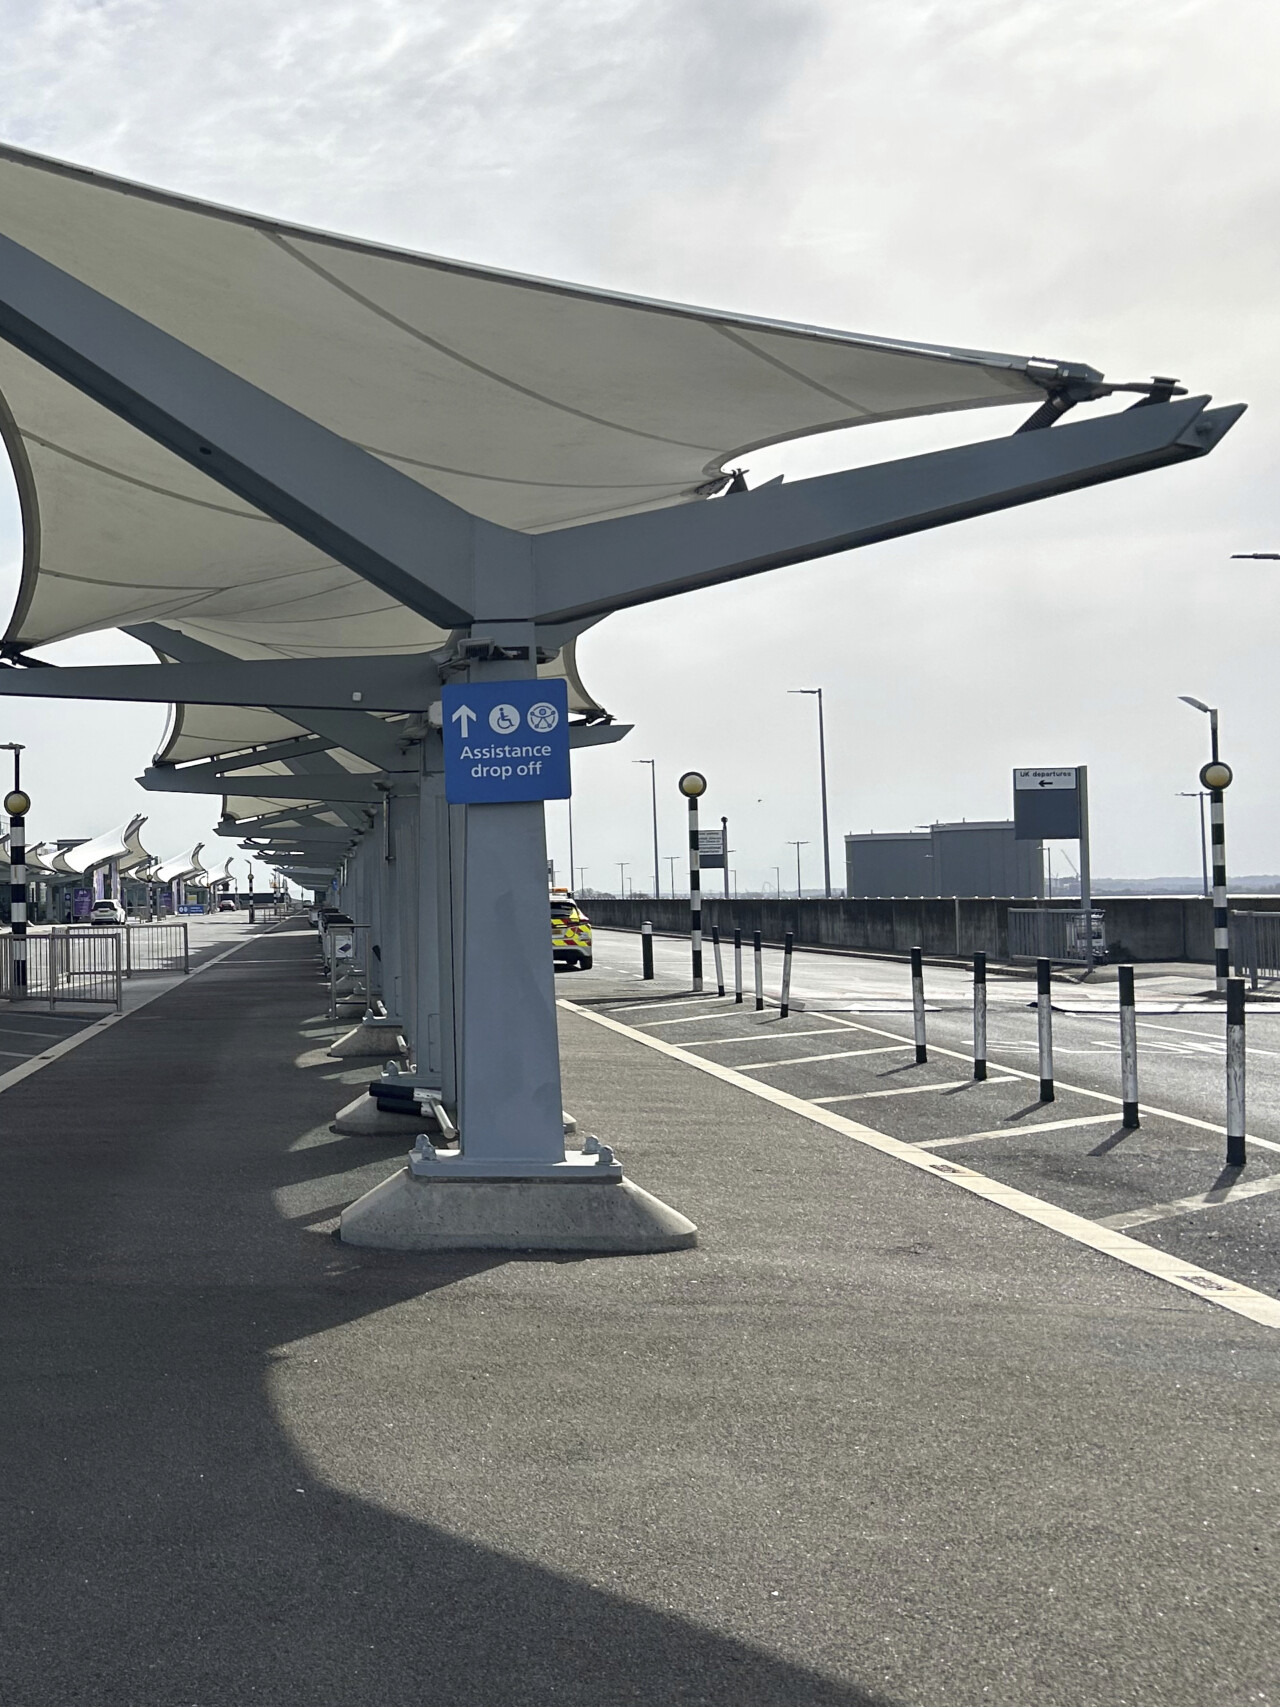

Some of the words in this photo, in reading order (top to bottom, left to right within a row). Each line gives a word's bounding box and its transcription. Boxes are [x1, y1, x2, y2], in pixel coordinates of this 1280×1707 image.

[460, 744, 551, 760] Assistance
[471, 763, 512, 780] drop
[516, 761, 542, 775] off
